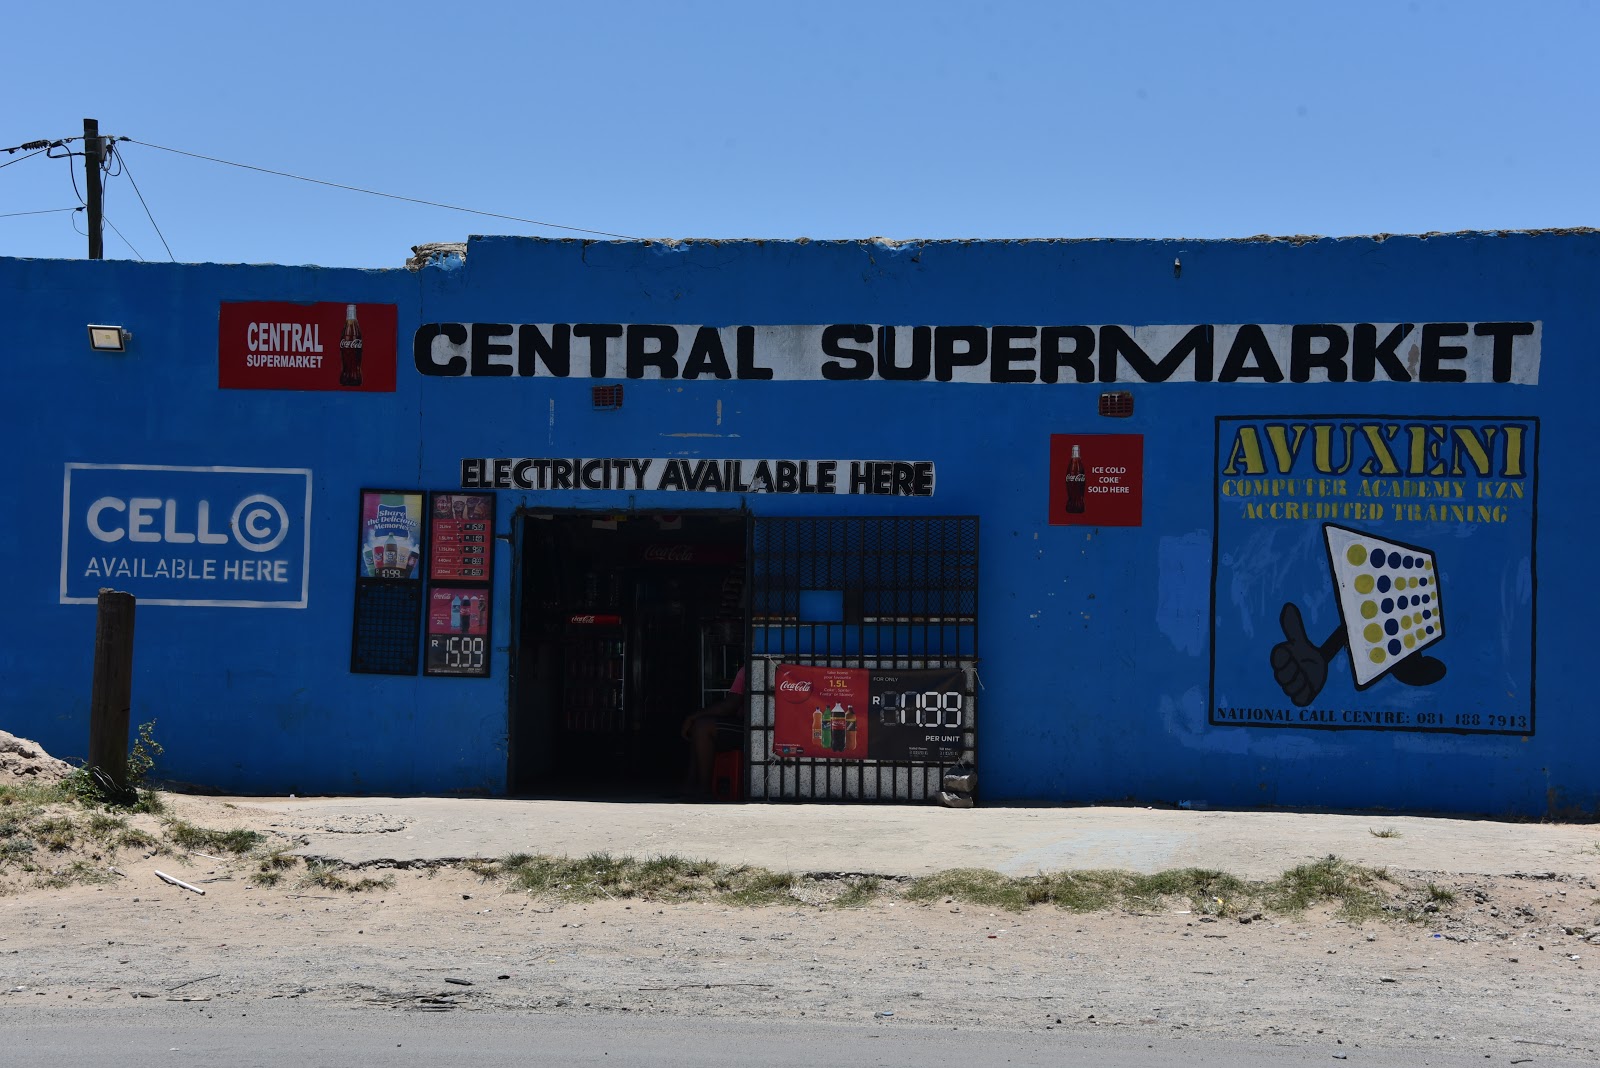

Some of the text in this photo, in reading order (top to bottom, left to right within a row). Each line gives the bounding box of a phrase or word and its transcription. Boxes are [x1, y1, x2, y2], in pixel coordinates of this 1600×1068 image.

[247, 322, 324, 353] CENTRAL
[246, 354, 323, 369] SUPERMARKET
[414, 322, 1535, 383] CENTRAL SUPERMARKET
[1222, 424, 1527, 478] AVUXENI
[460, 458, 933, 497] ELECTRICITY AVAILABLE HERE
[1222, 479, 1525, 499] COMPUTER ACADEMY KZN
[368, 516, 418, 527] the Delicious
[1242, 502, 1508, 523] ACCREDITED TRAINING
[84, 557, 289, 582] AVAILABLE HERE
[446, 637, 484, 668] 15.99
[780, 680, 812, 692] Coca-Cola
[872, 696, 880, 705] R
[1216, 708, 1293, 722] NATIONAL
[1299, 709, 1337, 722] CALL
[1342, 710, 1410, 724] CENTRE:
[1488, 714, 1527, 728] 7913
